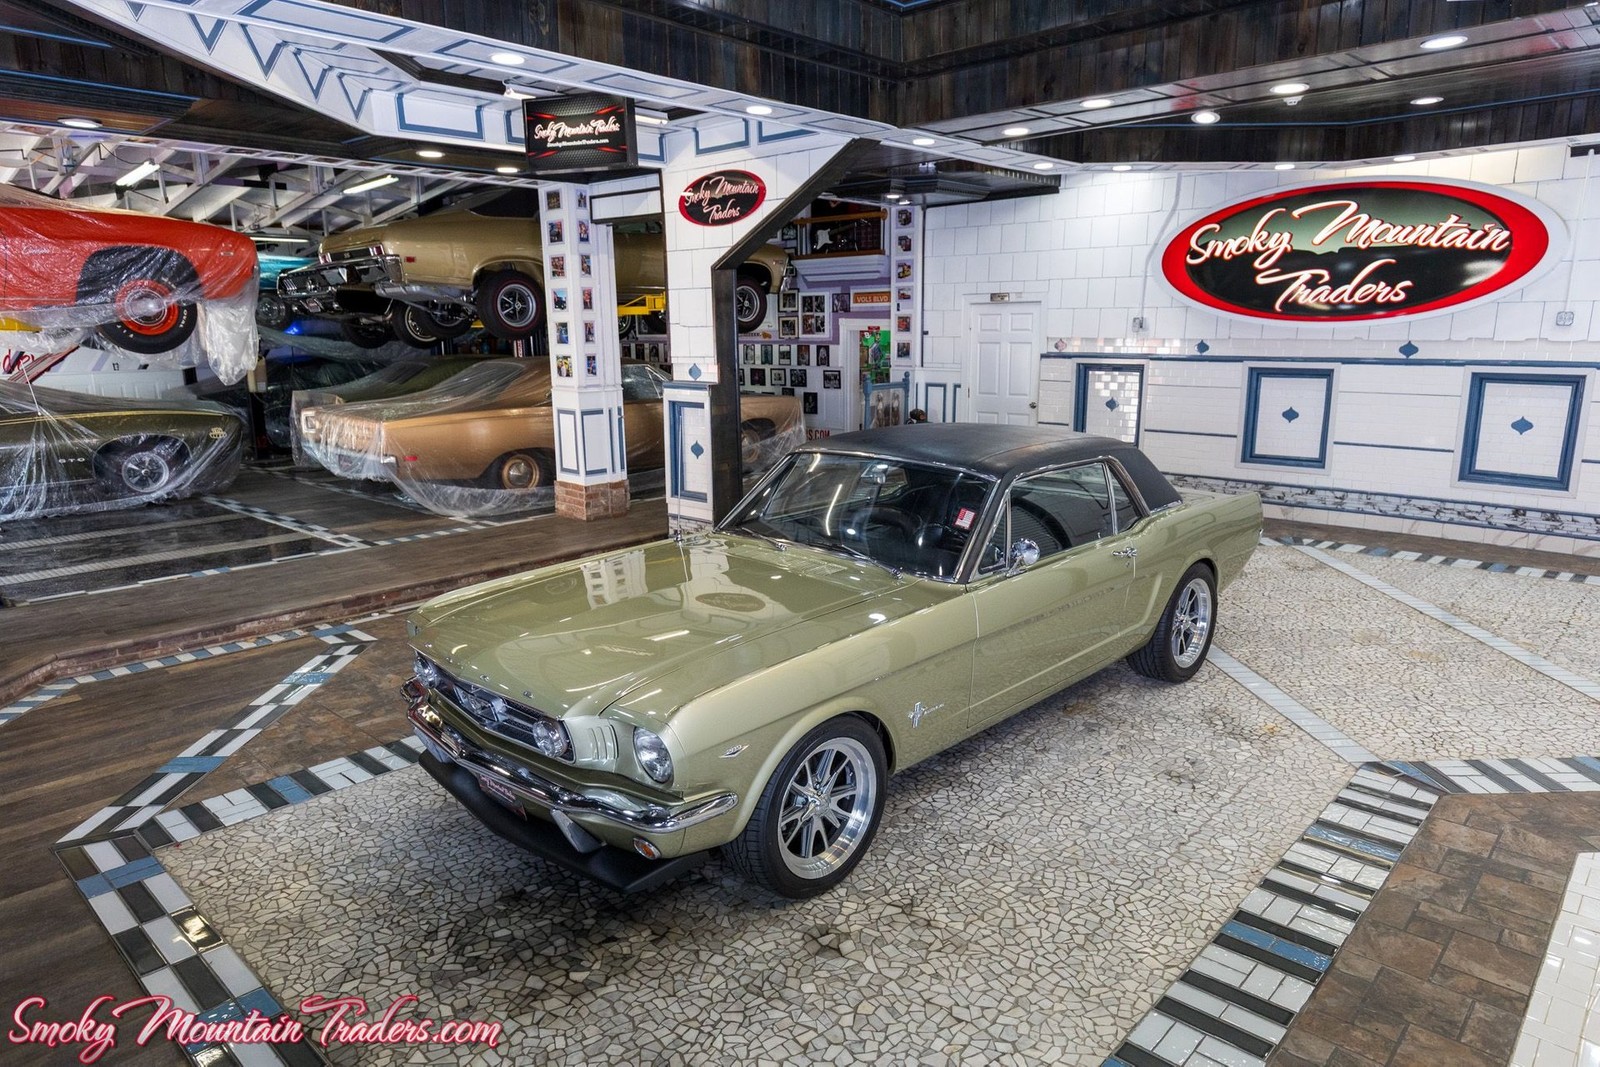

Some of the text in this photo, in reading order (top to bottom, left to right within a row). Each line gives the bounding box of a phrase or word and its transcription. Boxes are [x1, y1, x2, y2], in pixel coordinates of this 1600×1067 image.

[684, 176, 760, 206] Smoky Mountain
[703, 198, 741, 224] Traders
[1186, 200, 1511, 270] Smoky Mountain
[856, 295, 889, 304] VOLS BLVD
[1255, 259, 1414, 312] Traders
